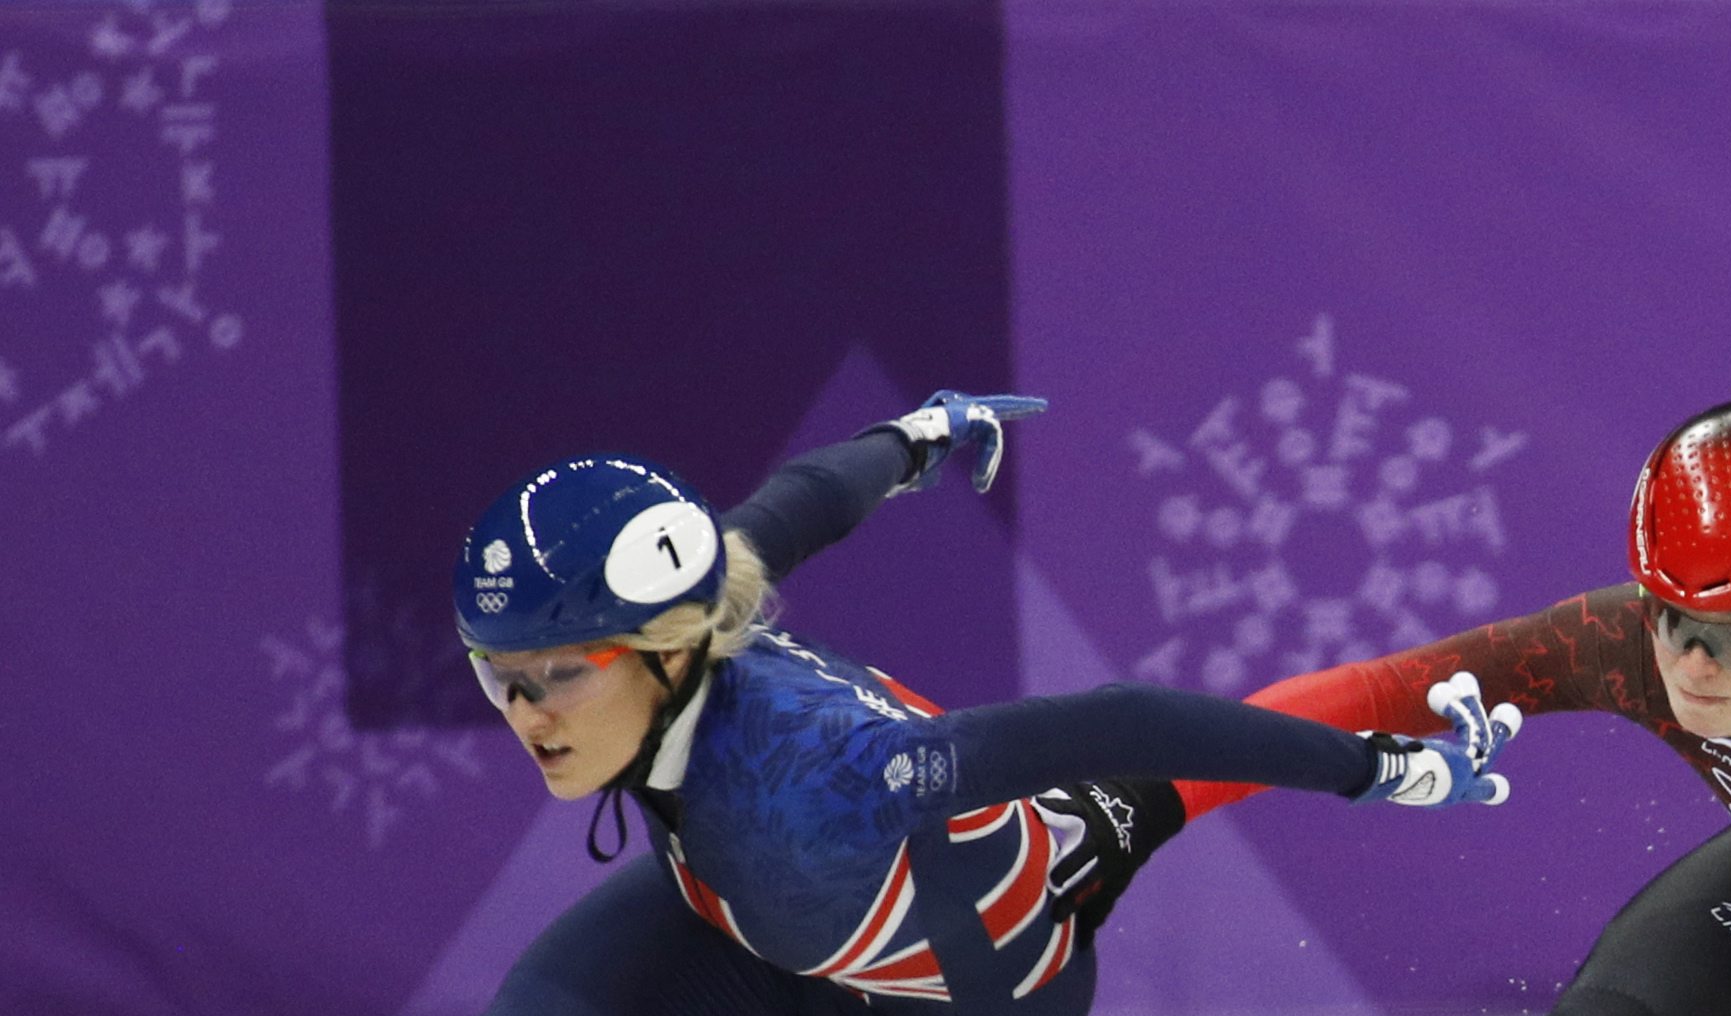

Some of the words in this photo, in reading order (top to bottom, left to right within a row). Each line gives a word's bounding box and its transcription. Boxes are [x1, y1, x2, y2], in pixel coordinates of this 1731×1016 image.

[655, 527, 681, 569] 1
[474, 577, 496, 588] TEAM
[498, 576, 514, 588] GB
[917, 746, 926, 763] GB
[917, 766, 926, 797] TEAM
